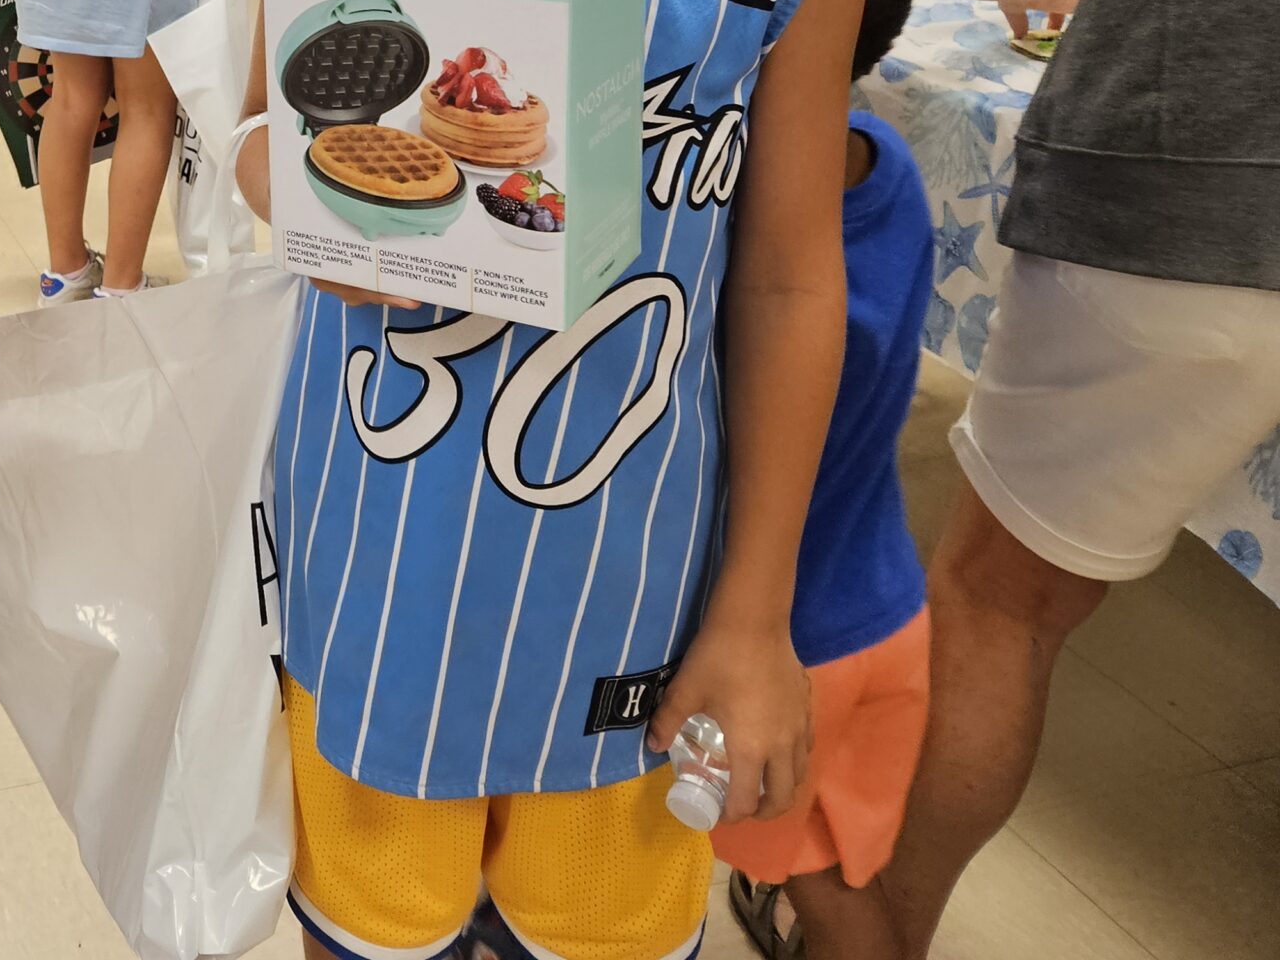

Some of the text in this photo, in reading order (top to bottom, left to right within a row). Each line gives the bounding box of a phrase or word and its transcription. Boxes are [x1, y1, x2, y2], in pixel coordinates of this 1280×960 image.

[286, 230, 318, 241] COMPACT
[319, 237, 333, 245] SIZE
[341, 241, 370, 253] PERFECT
[286, 238, 373, 262] FOR DORM ROOMS, SMALL
[287, 247, 353, 266] KITCHENS, CAMPERS
[287, 255, 322, 268] AND MORE
[378, 249, 468, 273] QUICKLY HEATS COOKING
[379, 258, 414, 271] SURFACES
[415, 265, 429, 273] FOR
[431, 268, 450, 278] EVEN
[379, 266, 457, 289] CONSISTENT COOKING
[473, 277, 549, 299] COOKING SURFACES
[474, 286, 545, 307] EASILY WIPE CLEAN
[345, 272, 687, 511] 30
[621, 684, 647, 718] H
